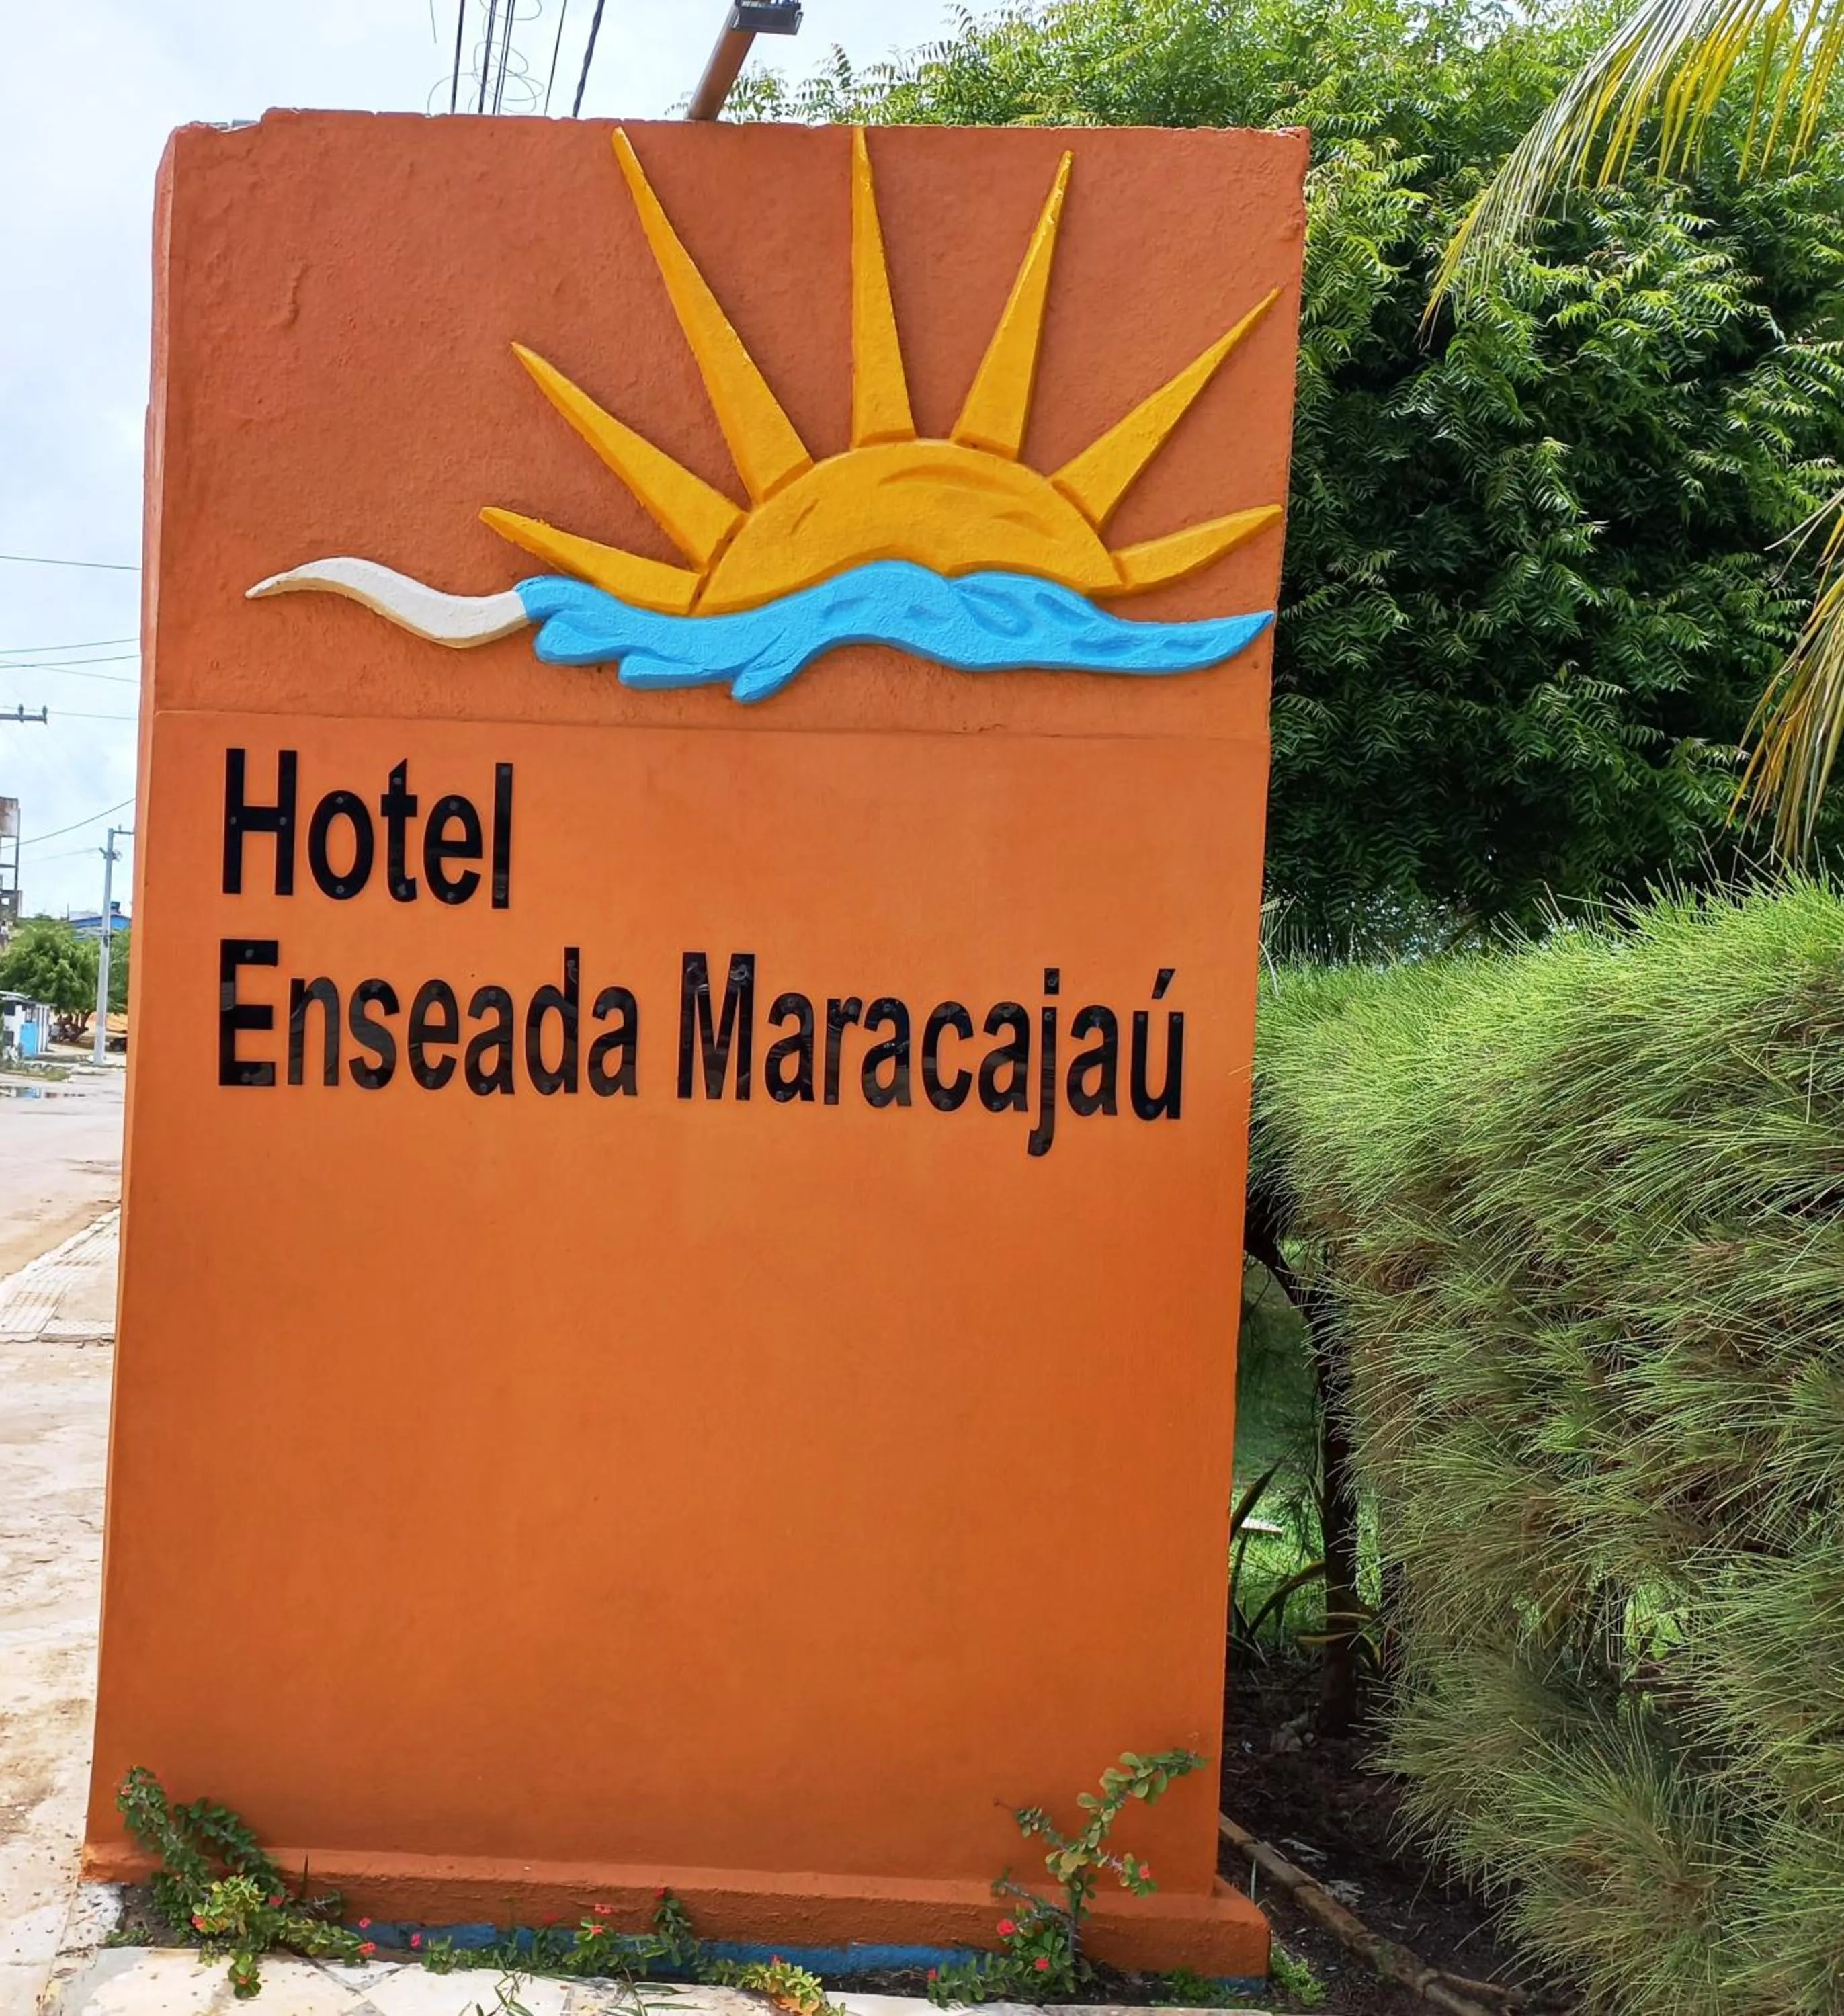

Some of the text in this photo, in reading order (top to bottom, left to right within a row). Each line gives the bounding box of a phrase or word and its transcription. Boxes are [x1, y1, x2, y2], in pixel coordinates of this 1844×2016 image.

[222, 748, 512, 909] Hotel
[219, 939, 1184, 1157] Enseada Maracajaú
